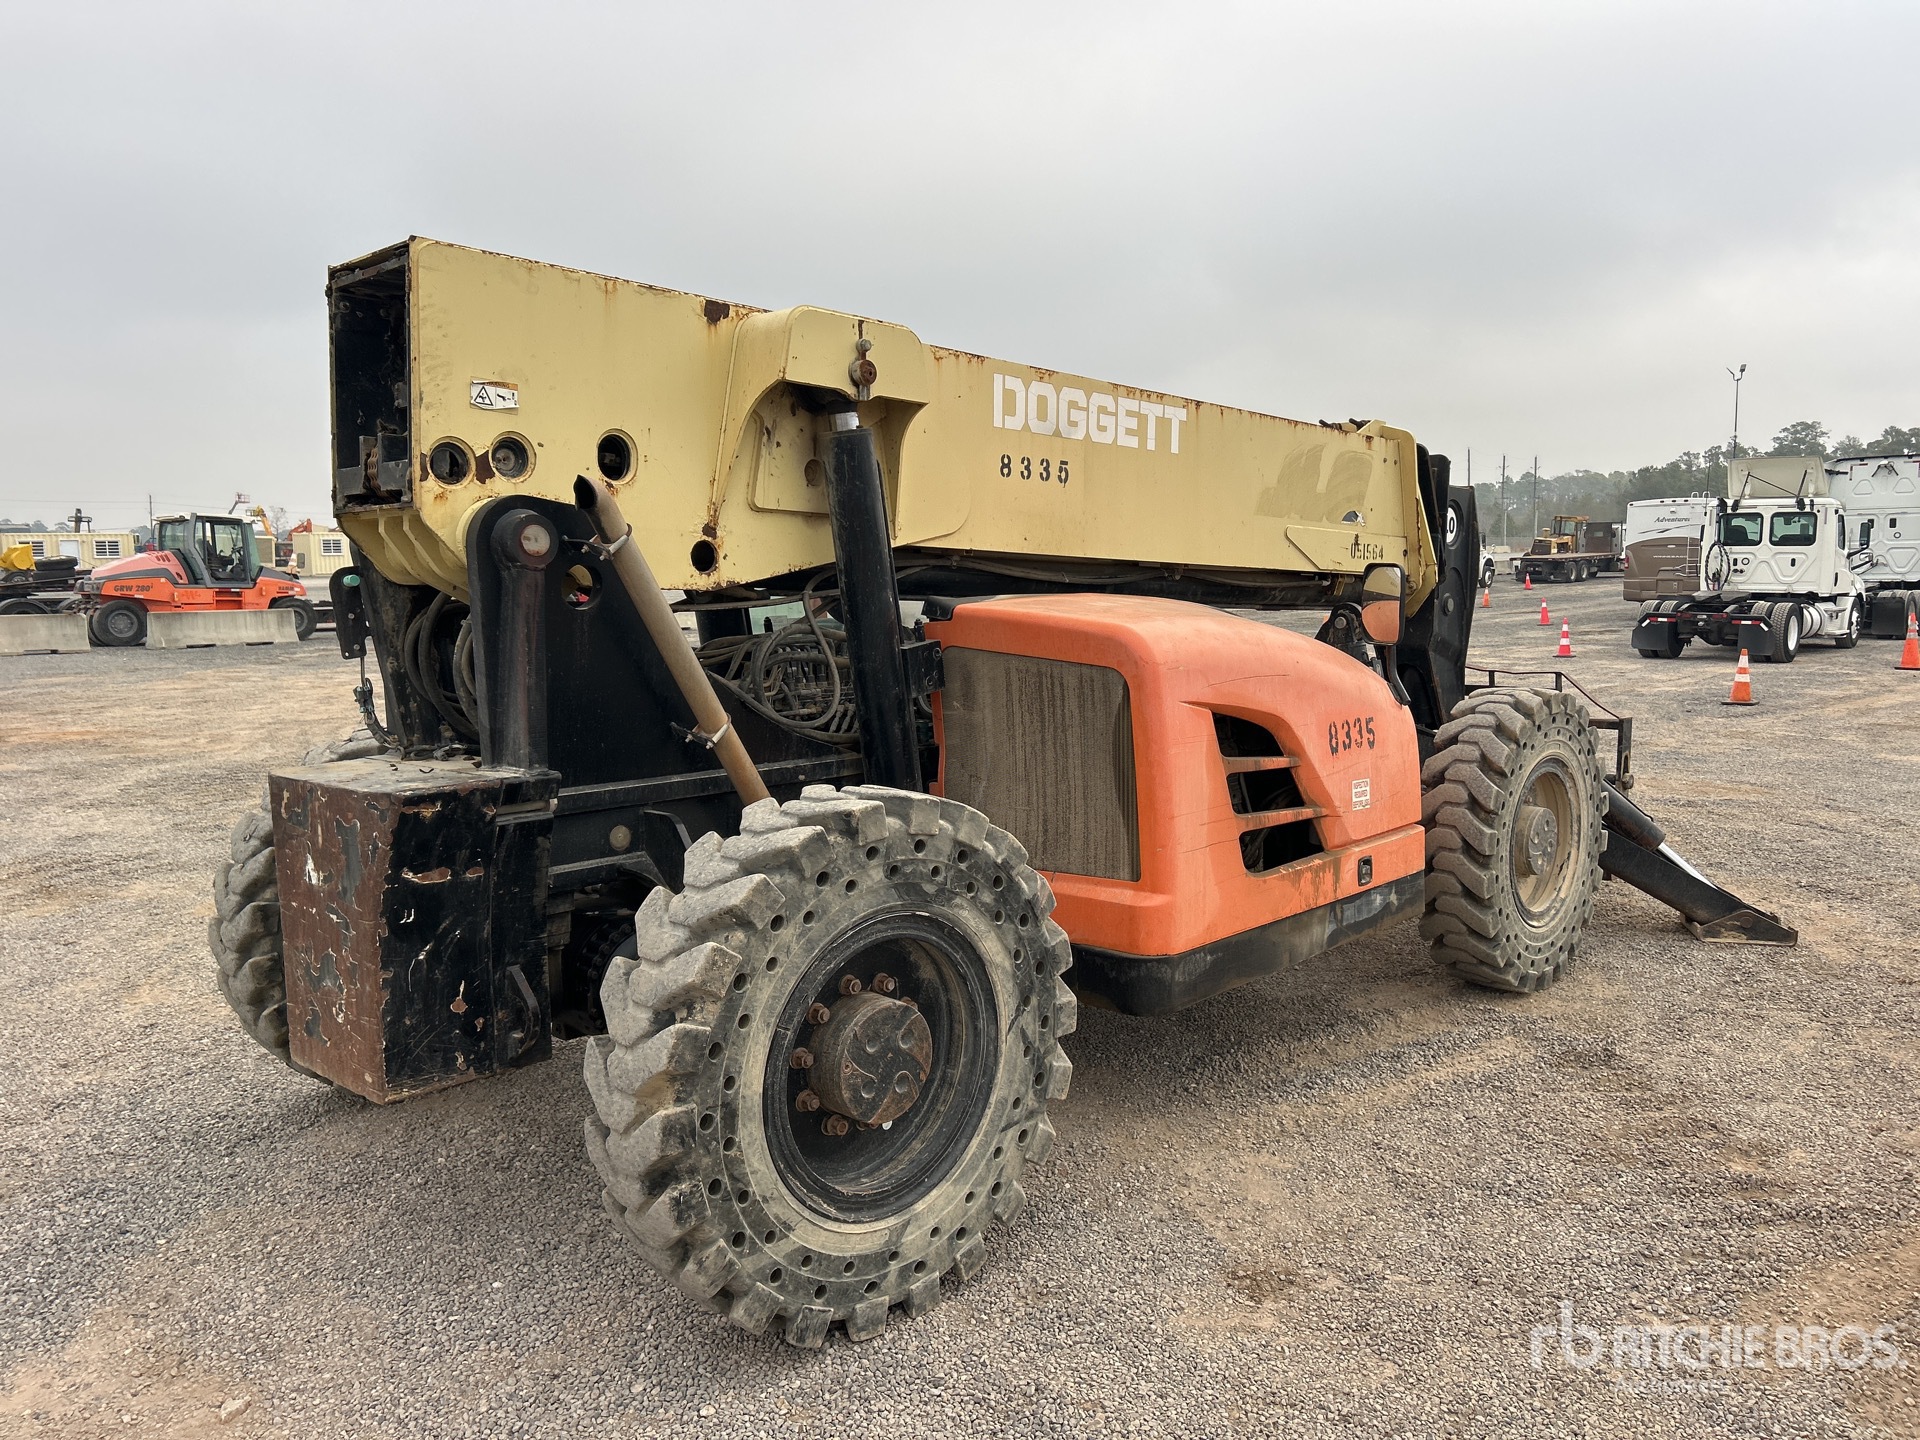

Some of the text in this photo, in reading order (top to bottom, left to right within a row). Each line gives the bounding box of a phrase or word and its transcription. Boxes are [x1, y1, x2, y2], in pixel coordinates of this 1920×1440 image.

[993, 373, 1187, 454] DOGGETT
[999, 453, 1070, 486] 8335
[113, 584, 134, 592] GRW
[1328, 716, 1375, 756] 8335
